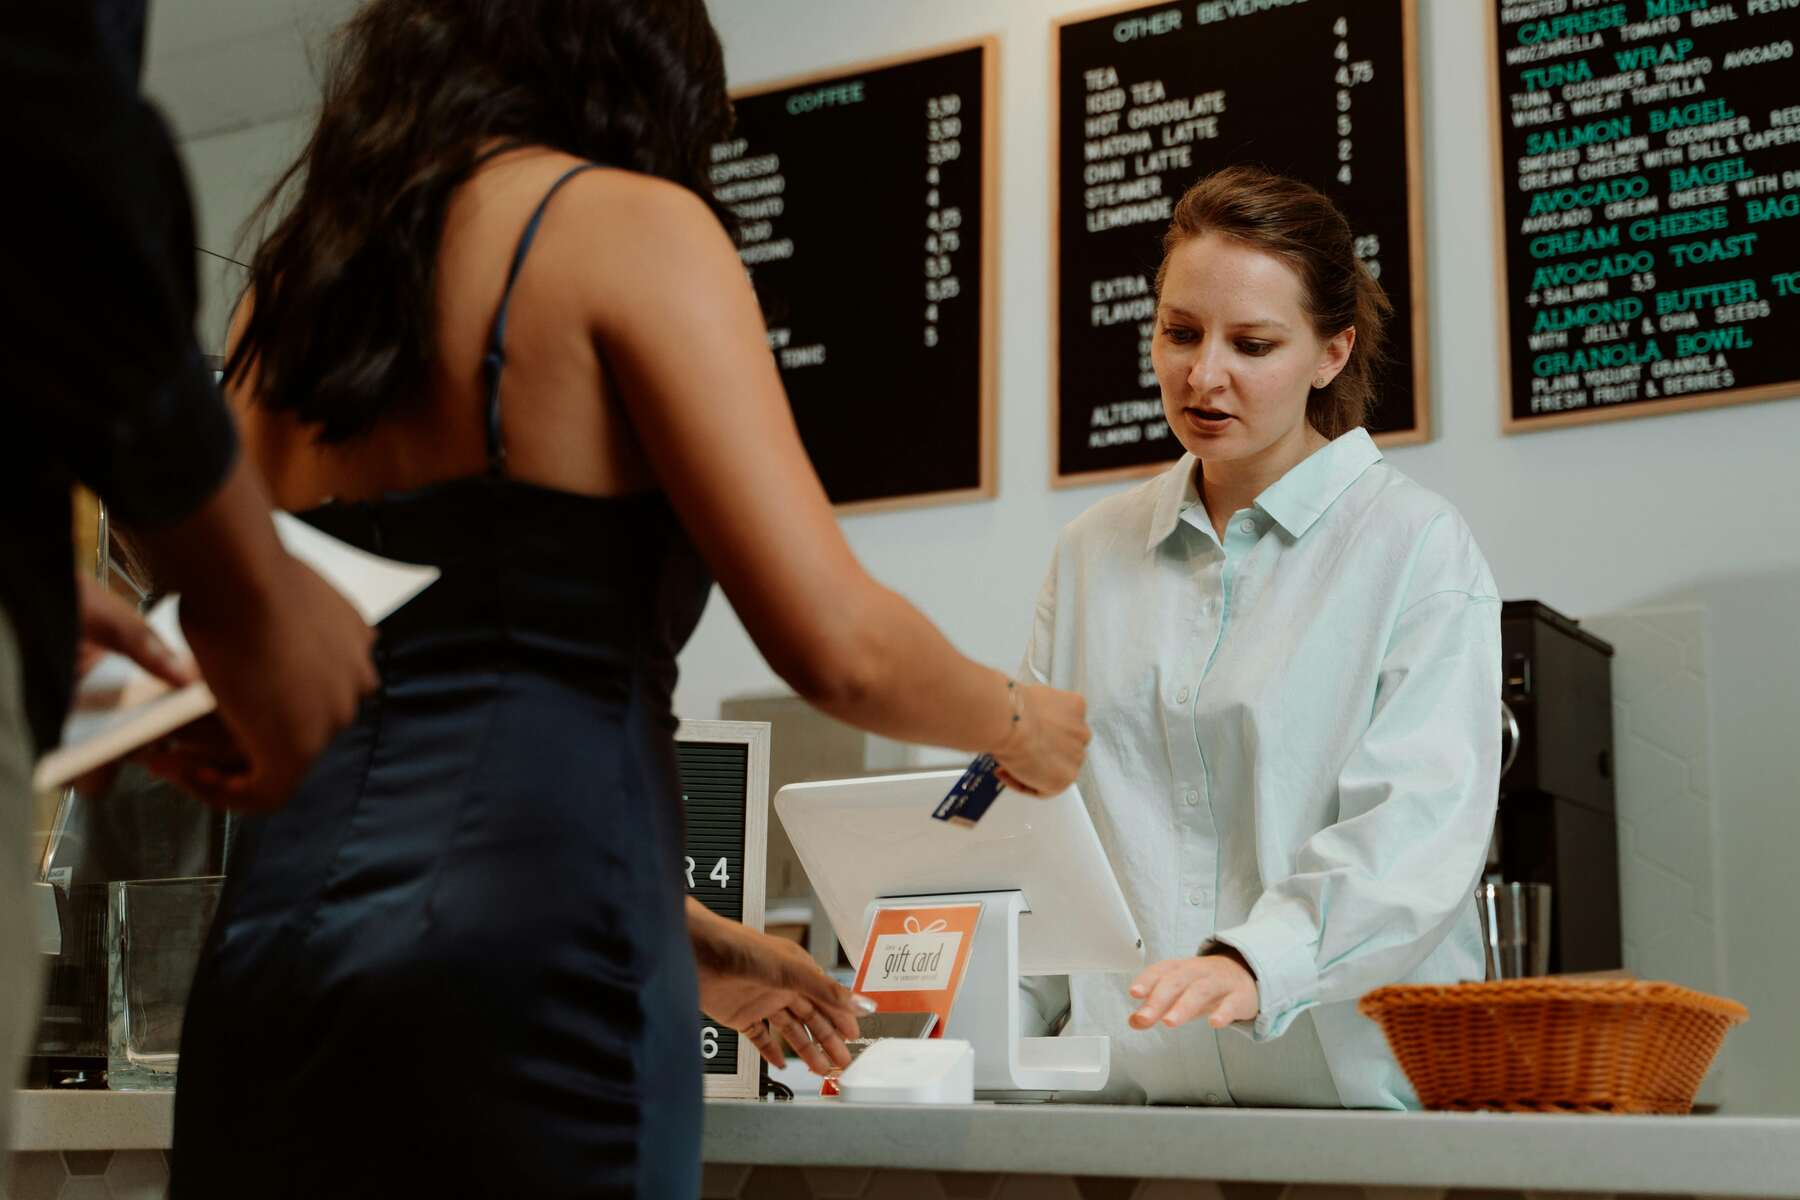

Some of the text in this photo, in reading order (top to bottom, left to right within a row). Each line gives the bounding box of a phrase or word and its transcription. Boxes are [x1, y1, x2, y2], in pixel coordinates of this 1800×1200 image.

[1113, 9, 1183, 43] OTHER
[1333, 16, 1348, 38] 4
[1517, 3, 1627, 46] CAPRESE
[1620, 15, 1680, 41] TOMATO
[1691, 3, 1738, 27] BASIL
[1334, 41, 1349, 62] 4
[1520, 38, 1694, 93] TUNA WRAP
[1084, 66, 1119, 91] TEA
[1510, 40, 1793, 110] TUNA CUCUMBER TOMATO AVOCADO
[786, 81, 864, 114] COFFEE
[1085, 79, 1166, 115] ICED TEA
[1085, 89, 1227, 138] HOT CHOCOLATE
[1336, 89, 1351, 112] 5
[1512, 77, 1705, 128] WHOLE WHEAT TORTILLA
[1084, 115, 1219, 161] MATCHA LATTE
[1337, 114, 1352, 136] 5
[1518, 105, 1800, 174] SMOKED SALMON CUCUMBER RED
[1526, 97, 1735, 156] SALMON BAGEL
[1084, 145, 1193, 186] CHAI LATTE
[1338, 138, 1352, 161] 2
[1519, 125, 1800, 192] CREAM CHEESE WITH DILL & CAPERS
[1084, 175, 1162, 209] STEAMER
[1338, 163, 1352, 184] 4
[1530, 157, 1754, 216] AVOCADO BAGEL
[1086, 196, 1173, 233] LEMONADE
[1521, 207, 1593, 235] AVOCADO
[1604, 195, 1659, 220] CREAM
[1668, 183, 1729, 209] CHEESE
[1736, 174, 1779, 197] WITH
[1530, 194, 1800, 258] CREAM CHEESE BAG
[1532, 232, 1758, 289] AVOCADO TOAST
[1091, 275, 1148, 303] EXTRA
[1534, 297, 1643, 332] ALMOND
[1656, 279, 1758, 315] BUTTER
[1543, 279, 1609, 305] SALMON
[1528, 299, 1770, 351] WITH JELLY & CHIA SEEDS
[1533, 326, 1753, 378] GRANOLA BOWL
[1531, 352, 1728, 394] PLAIN YOGURT GRANOLA
[1531, 369, 1735, 413] FRESH FRUIT & BERRIES
[1091, 398, 1166, 427] ALTERNA
[709, 857, 729, 889] 4
[882, 943, 944, 979] gift card
[702, 1026, 719, 1059] 6
